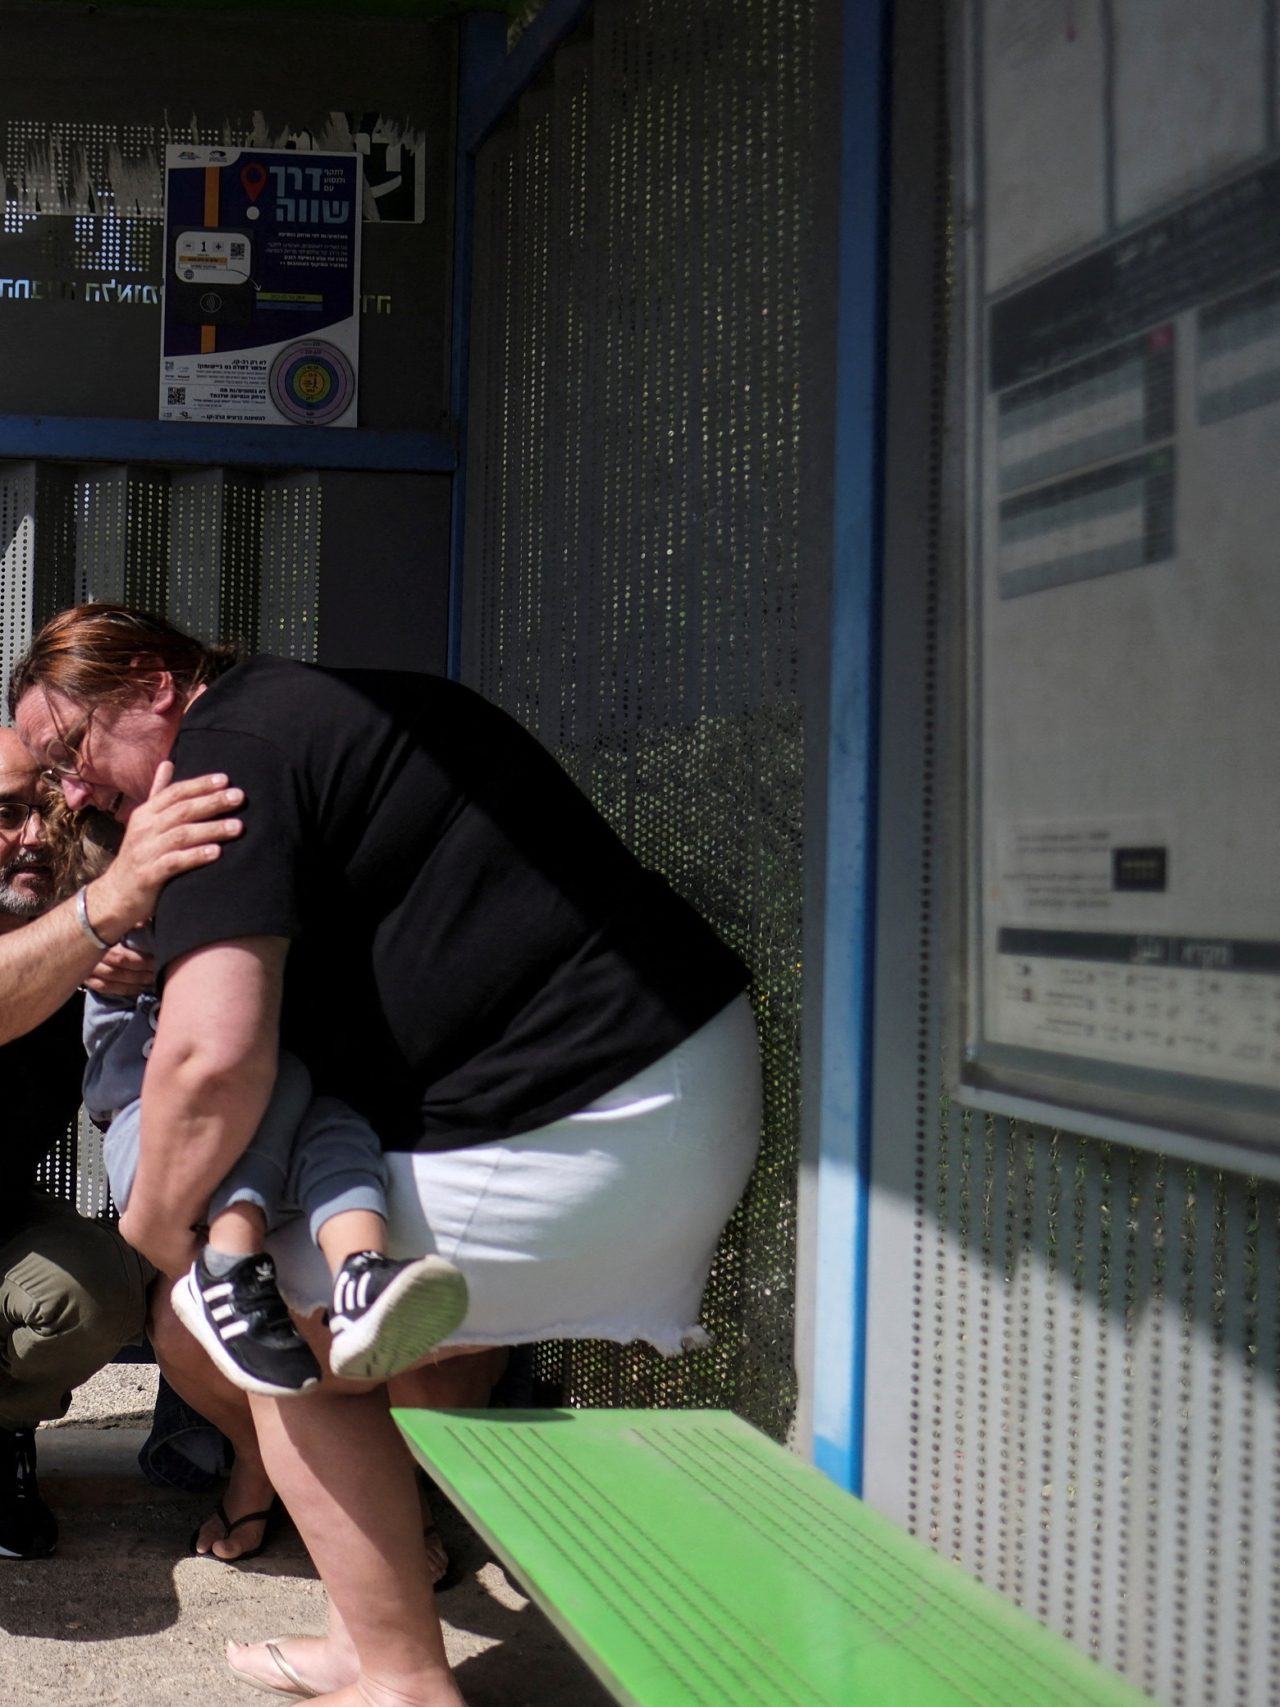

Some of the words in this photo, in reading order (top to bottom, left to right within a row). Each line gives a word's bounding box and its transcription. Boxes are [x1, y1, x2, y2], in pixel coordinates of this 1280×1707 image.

[269, 166, 322, 197] דרך
[276, 198, 349, 224] שווה
[201, 241, 206, 252] 1
